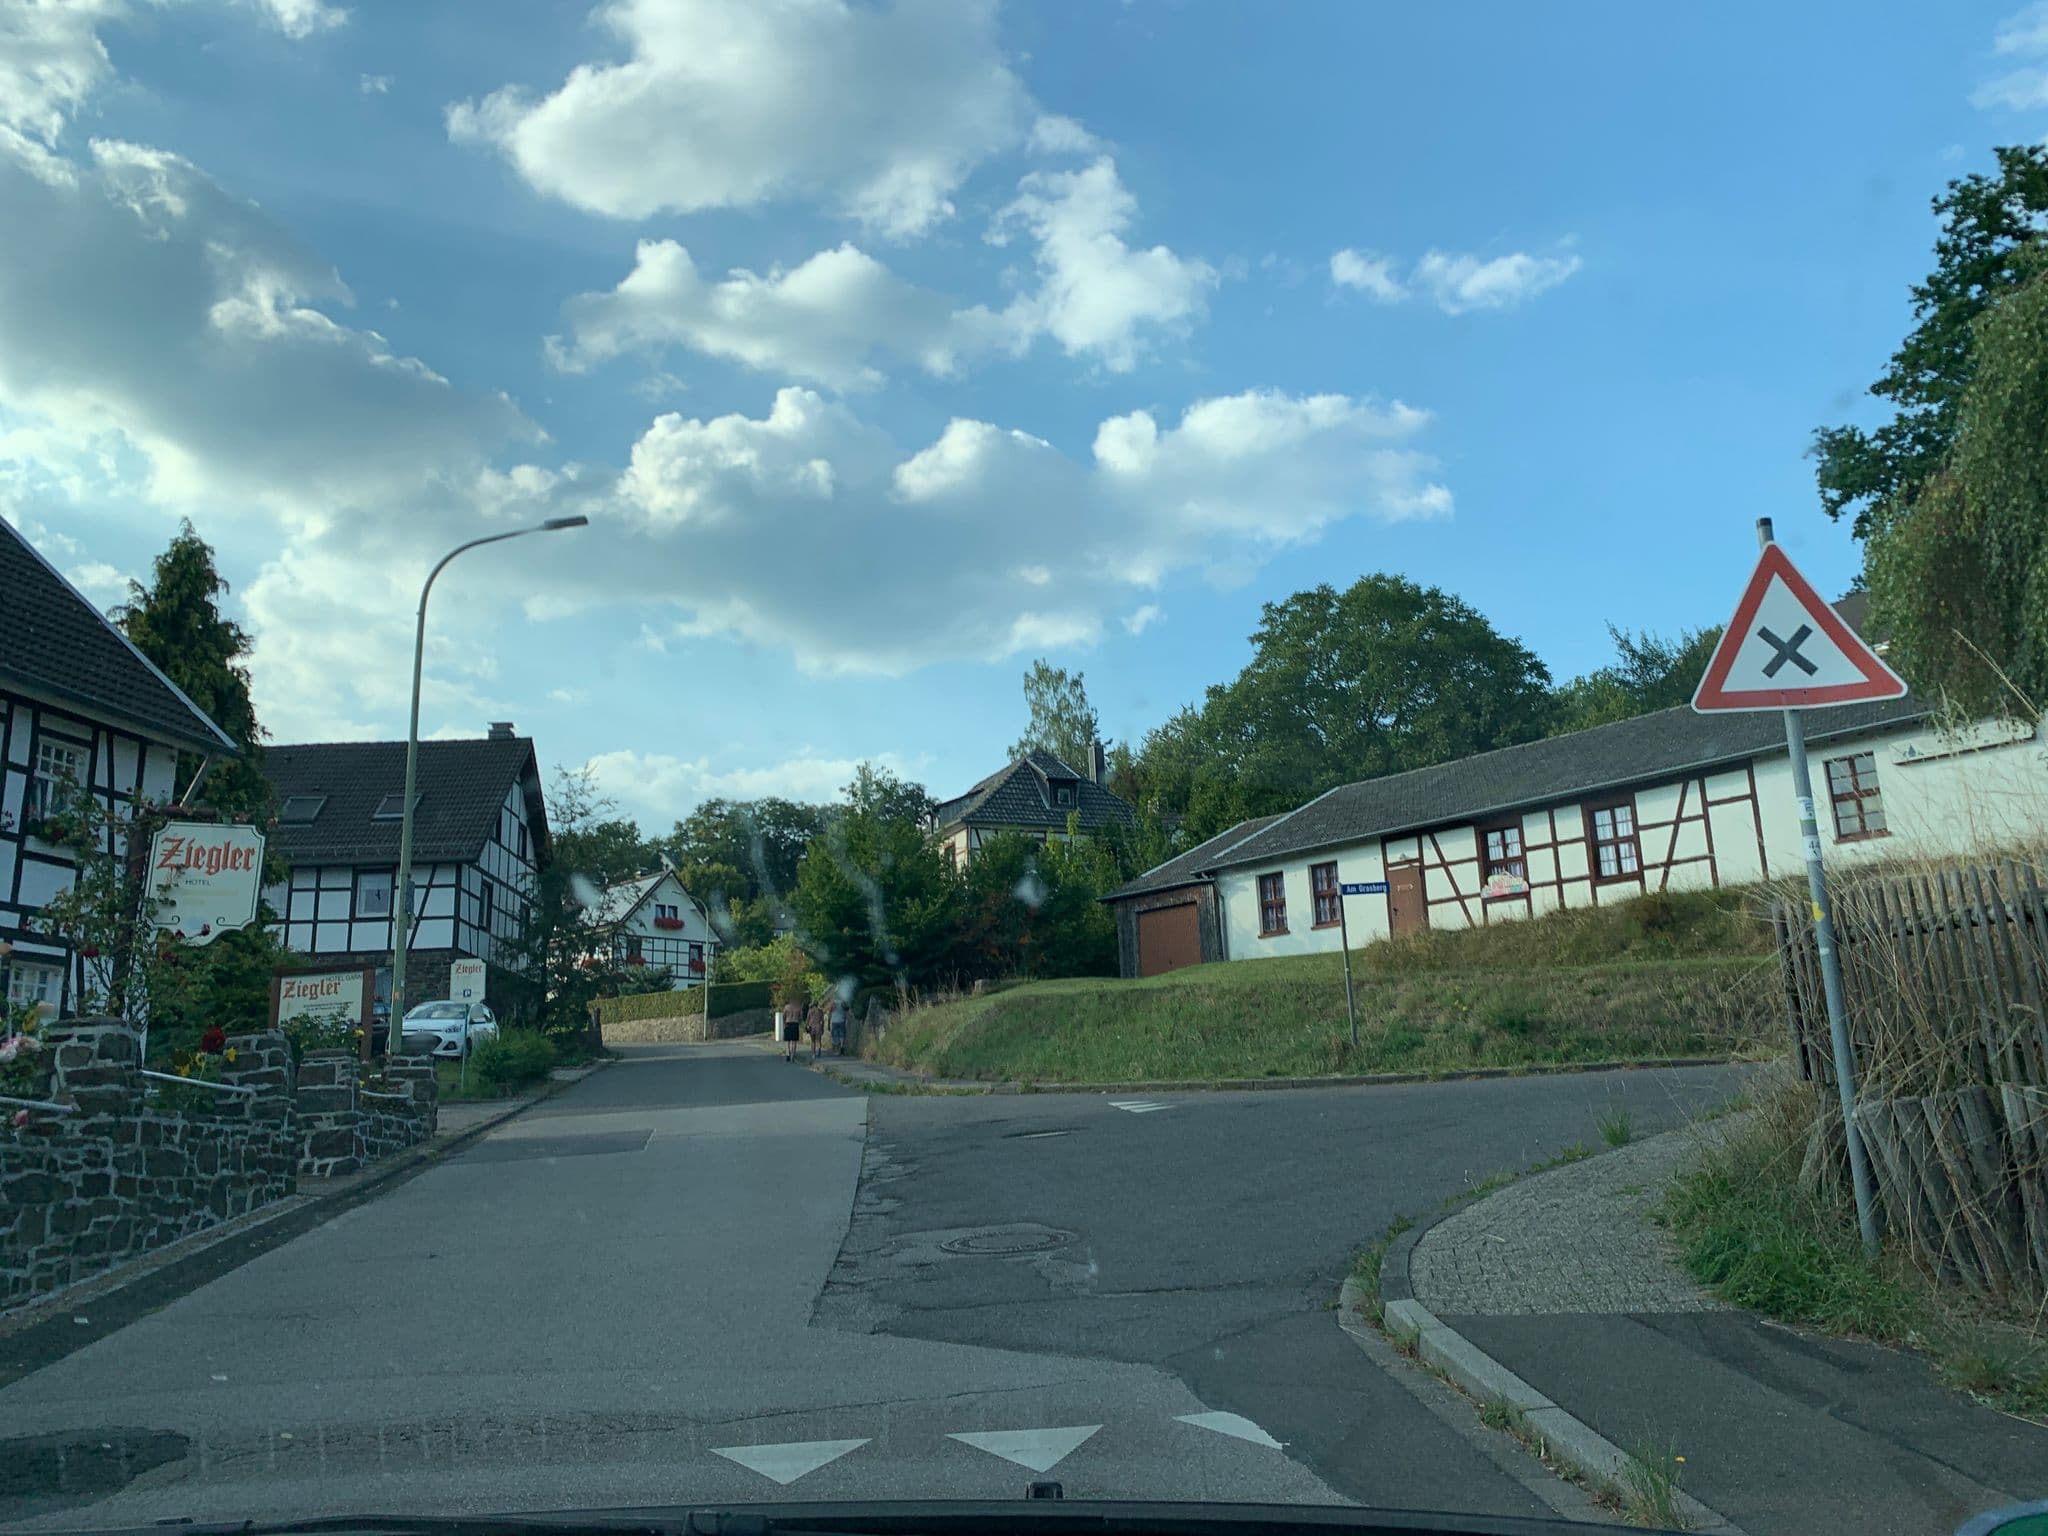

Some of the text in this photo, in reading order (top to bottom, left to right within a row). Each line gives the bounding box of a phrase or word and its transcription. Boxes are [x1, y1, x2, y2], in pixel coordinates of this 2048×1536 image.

[156, 837, 255, 876] Ziegler
[185, 879, 212, 887] HOTEL
[1347, 885, 1357, 893] Am
[455, 963, 483, 975] Ziegler
[282, 979, 341, 1001] Ziegler
